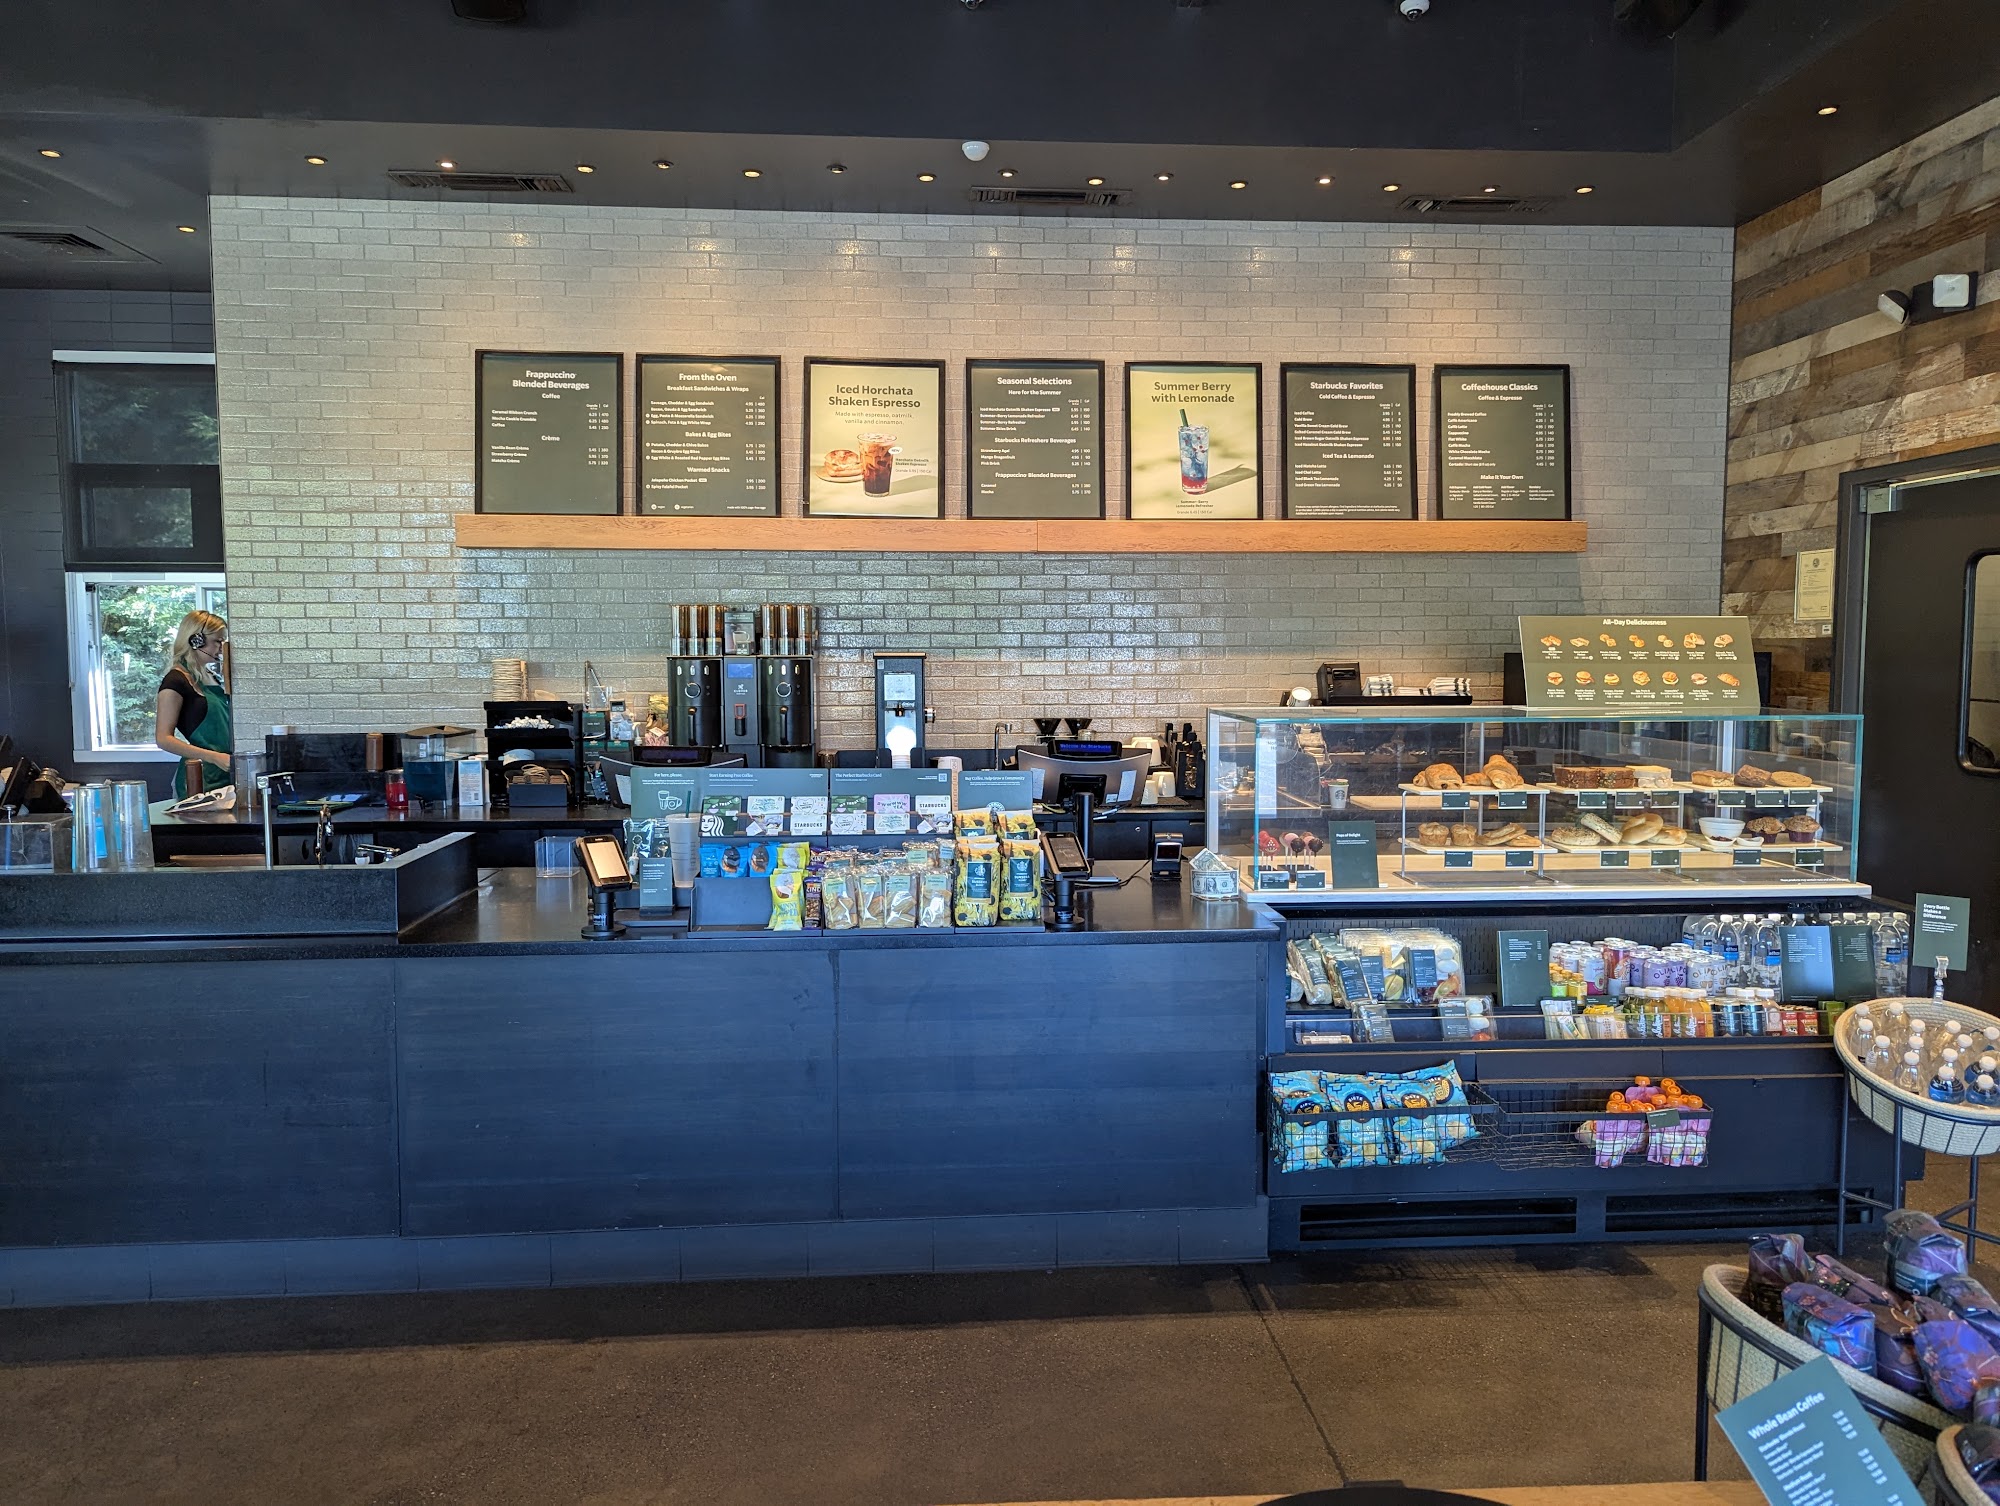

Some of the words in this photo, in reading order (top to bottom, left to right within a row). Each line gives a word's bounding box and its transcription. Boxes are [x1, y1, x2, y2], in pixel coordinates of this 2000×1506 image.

[526, 370, 576, 380] Frappuccino
[513, 380, 547, 388] Blended
[548, 381, 589, 390] Beverages
[836, 385, 859, 394] Iced
[862, 386, 913, 395] Horchata
[1154, 382, 1199, 391] Summer
[1202, 382, 1231, 392] Berry
[828, 397, 869, 406] Shaken
[872, 398, 921, 408] Espresso
[1152, 394, 1176, 402] with
[1178, 394, 1234, 402] Lemonade
[1748, 1416, 1778, 1440] Whole
[1775, 1407, 1798, 1425] Bean
[1796, 1392, 1825, 1412] Coffee
